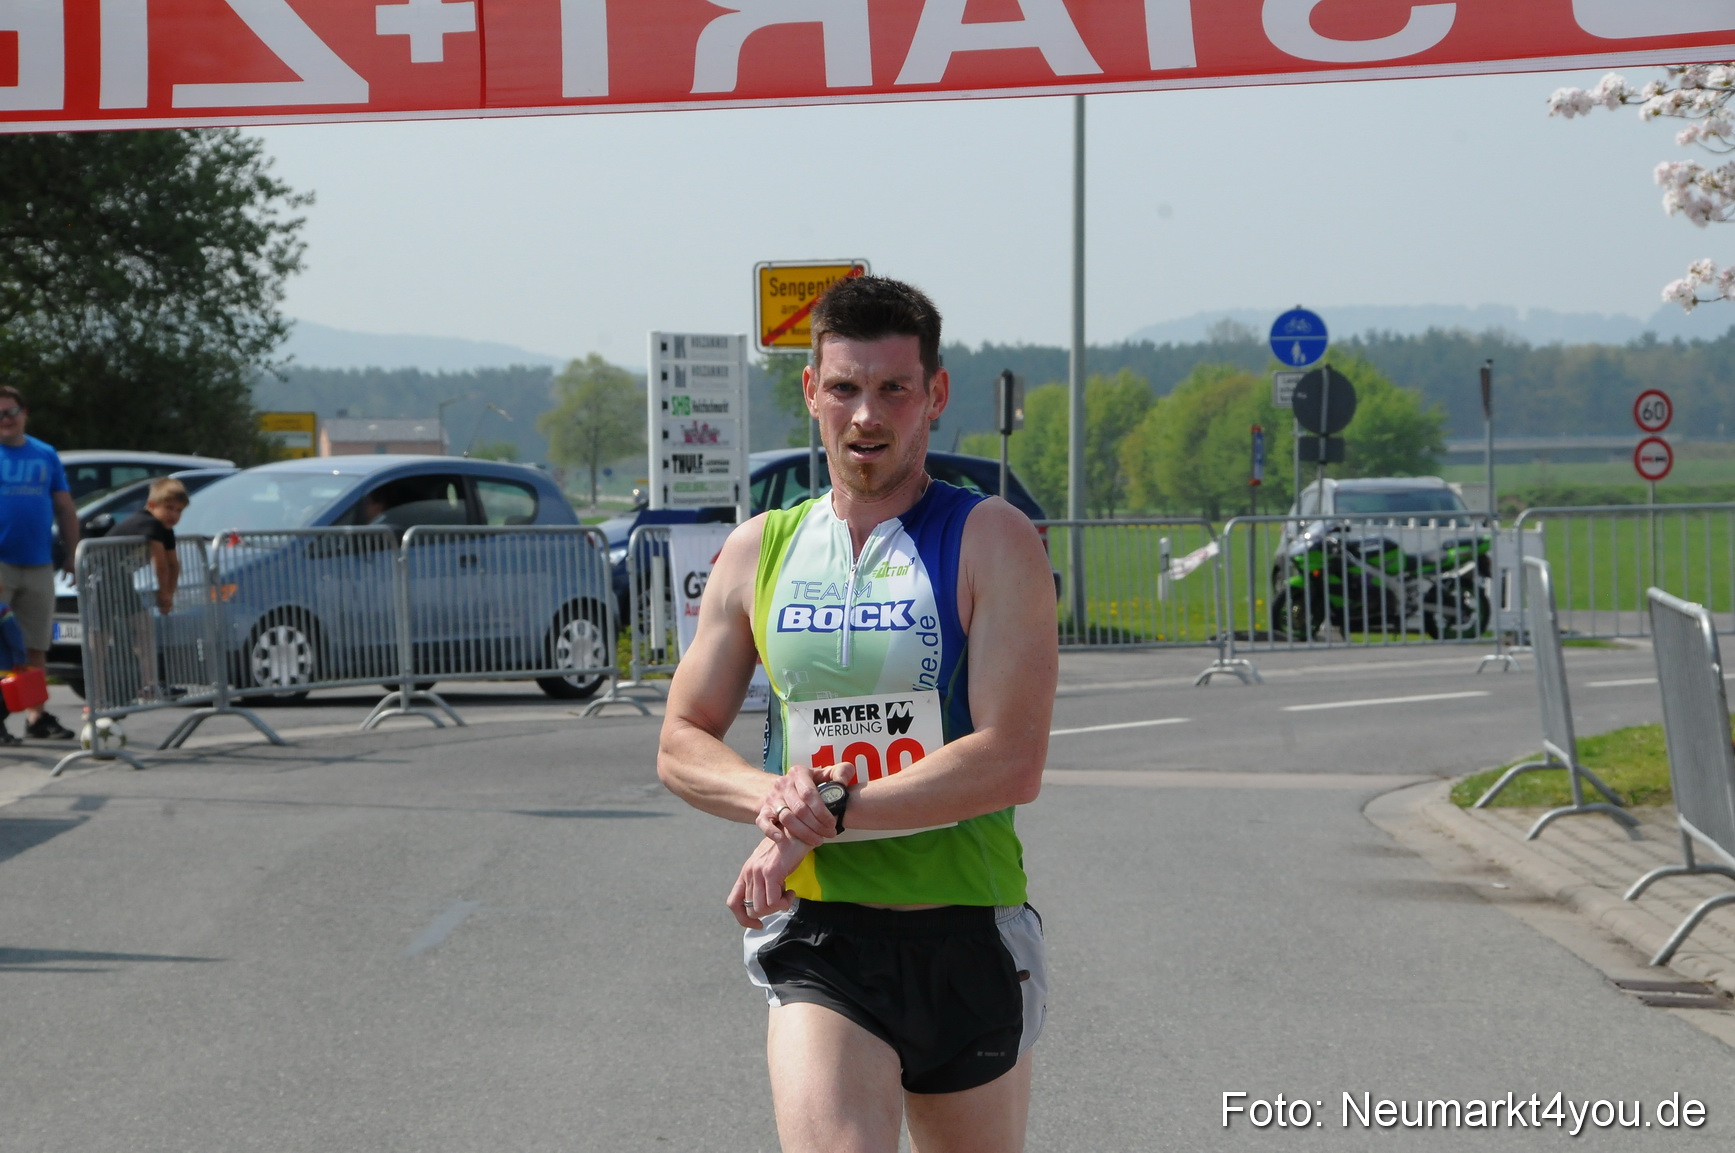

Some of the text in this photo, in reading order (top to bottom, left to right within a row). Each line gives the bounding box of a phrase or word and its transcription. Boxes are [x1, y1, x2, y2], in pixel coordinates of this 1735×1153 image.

[1642, 401, 1666, 421] 60
[791, 580, 873, 601] TEAM
[777, 599, 917, 633] BOCK
[813, 703, 882, 725] MEYER
[813, 721, 883, 737] WERBUNG
